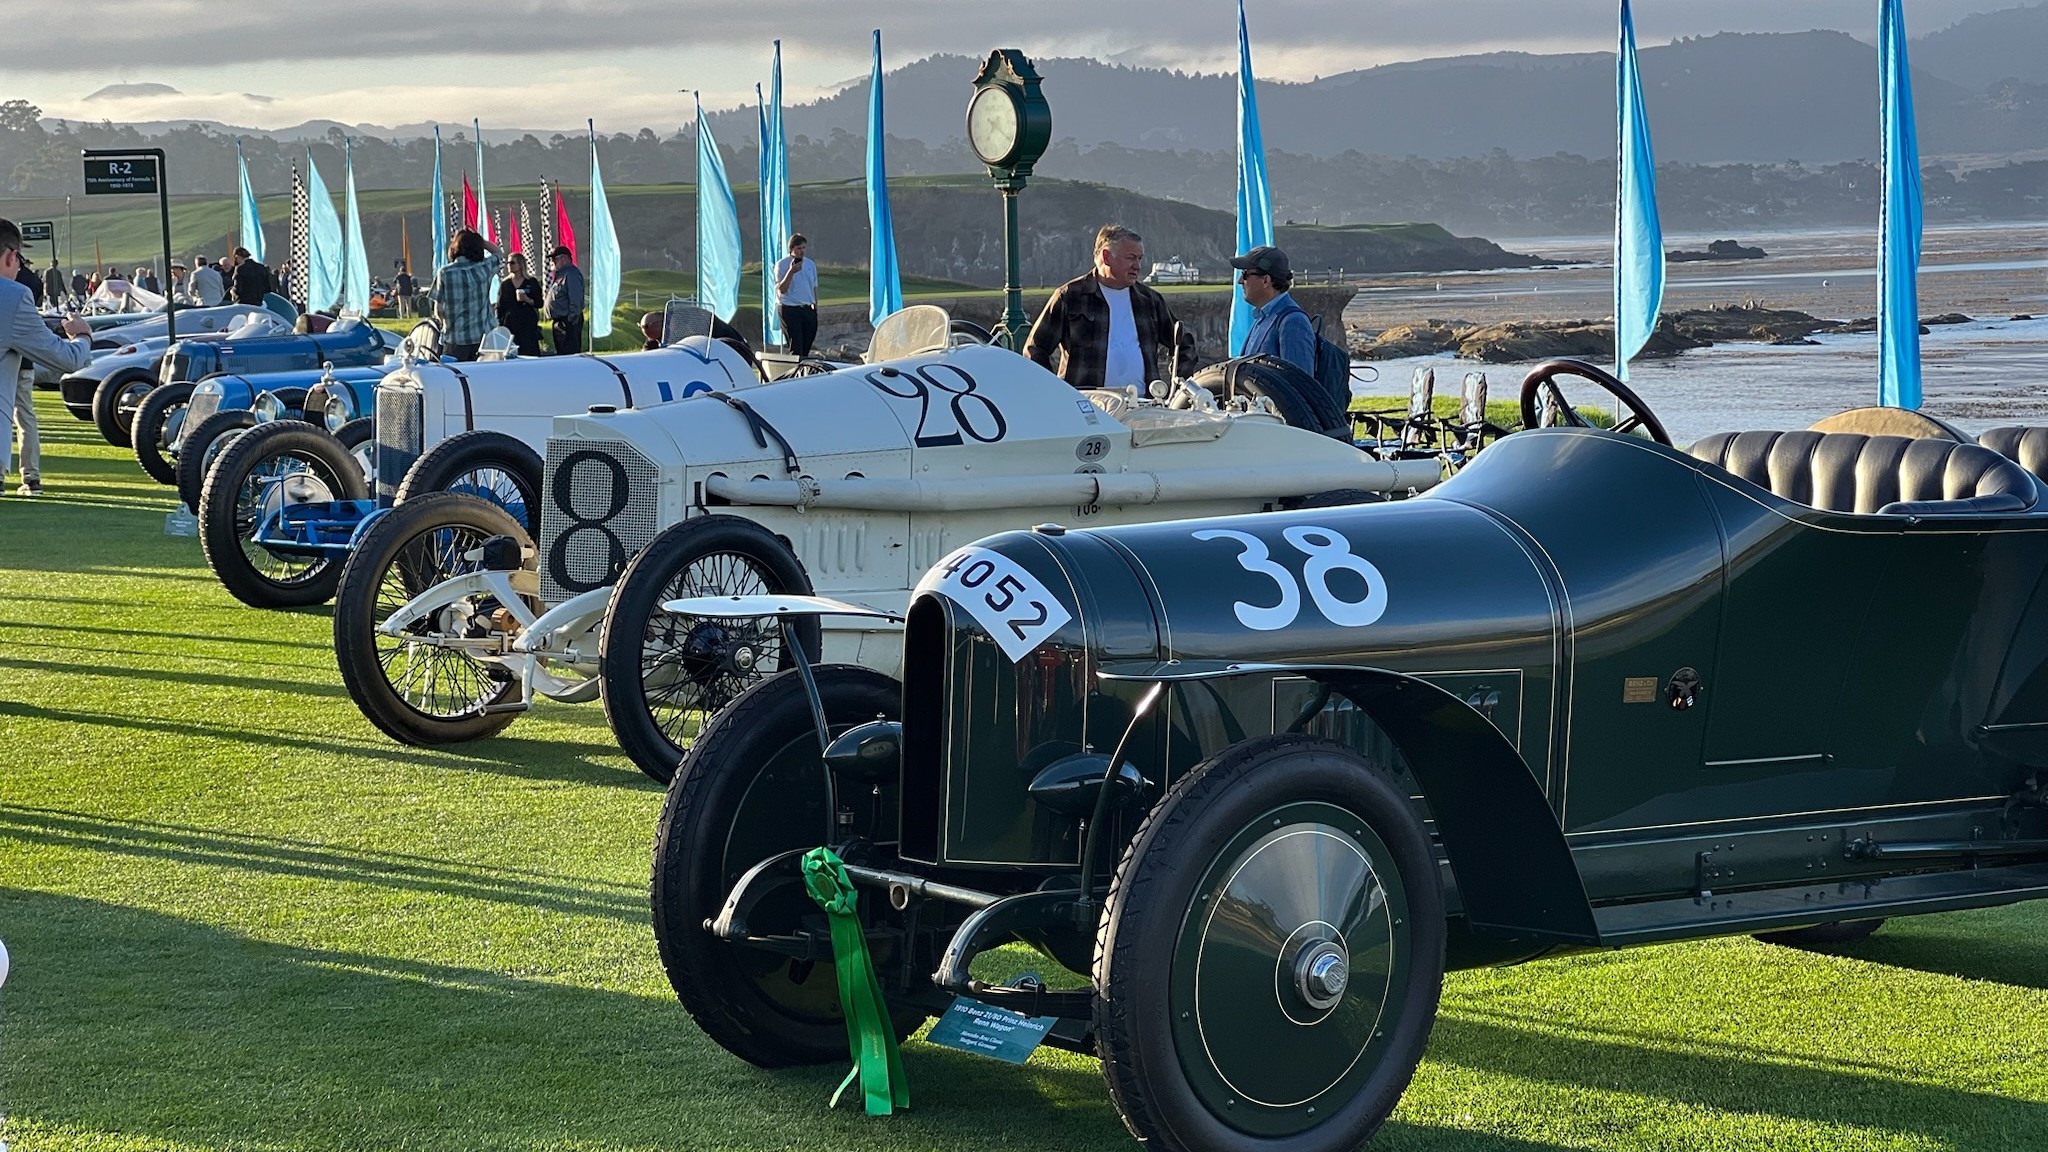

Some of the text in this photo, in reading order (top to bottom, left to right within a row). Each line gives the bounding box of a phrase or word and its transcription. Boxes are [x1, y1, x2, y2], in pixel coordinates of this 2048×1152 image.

[109, 162, 132, 174] R-2
[549, 450, 630, 593] 8
[1191, 525, 1388, 631] 38
[953, 1004, 969, 1013] 1910
[968, 1007, 984, 1017] Benz
[1001, 1014, 1018, 1026] Prinz
[1017, 1018, 1044, 1031] Heinrich
[972, 1017, 990, 1027] Renn
